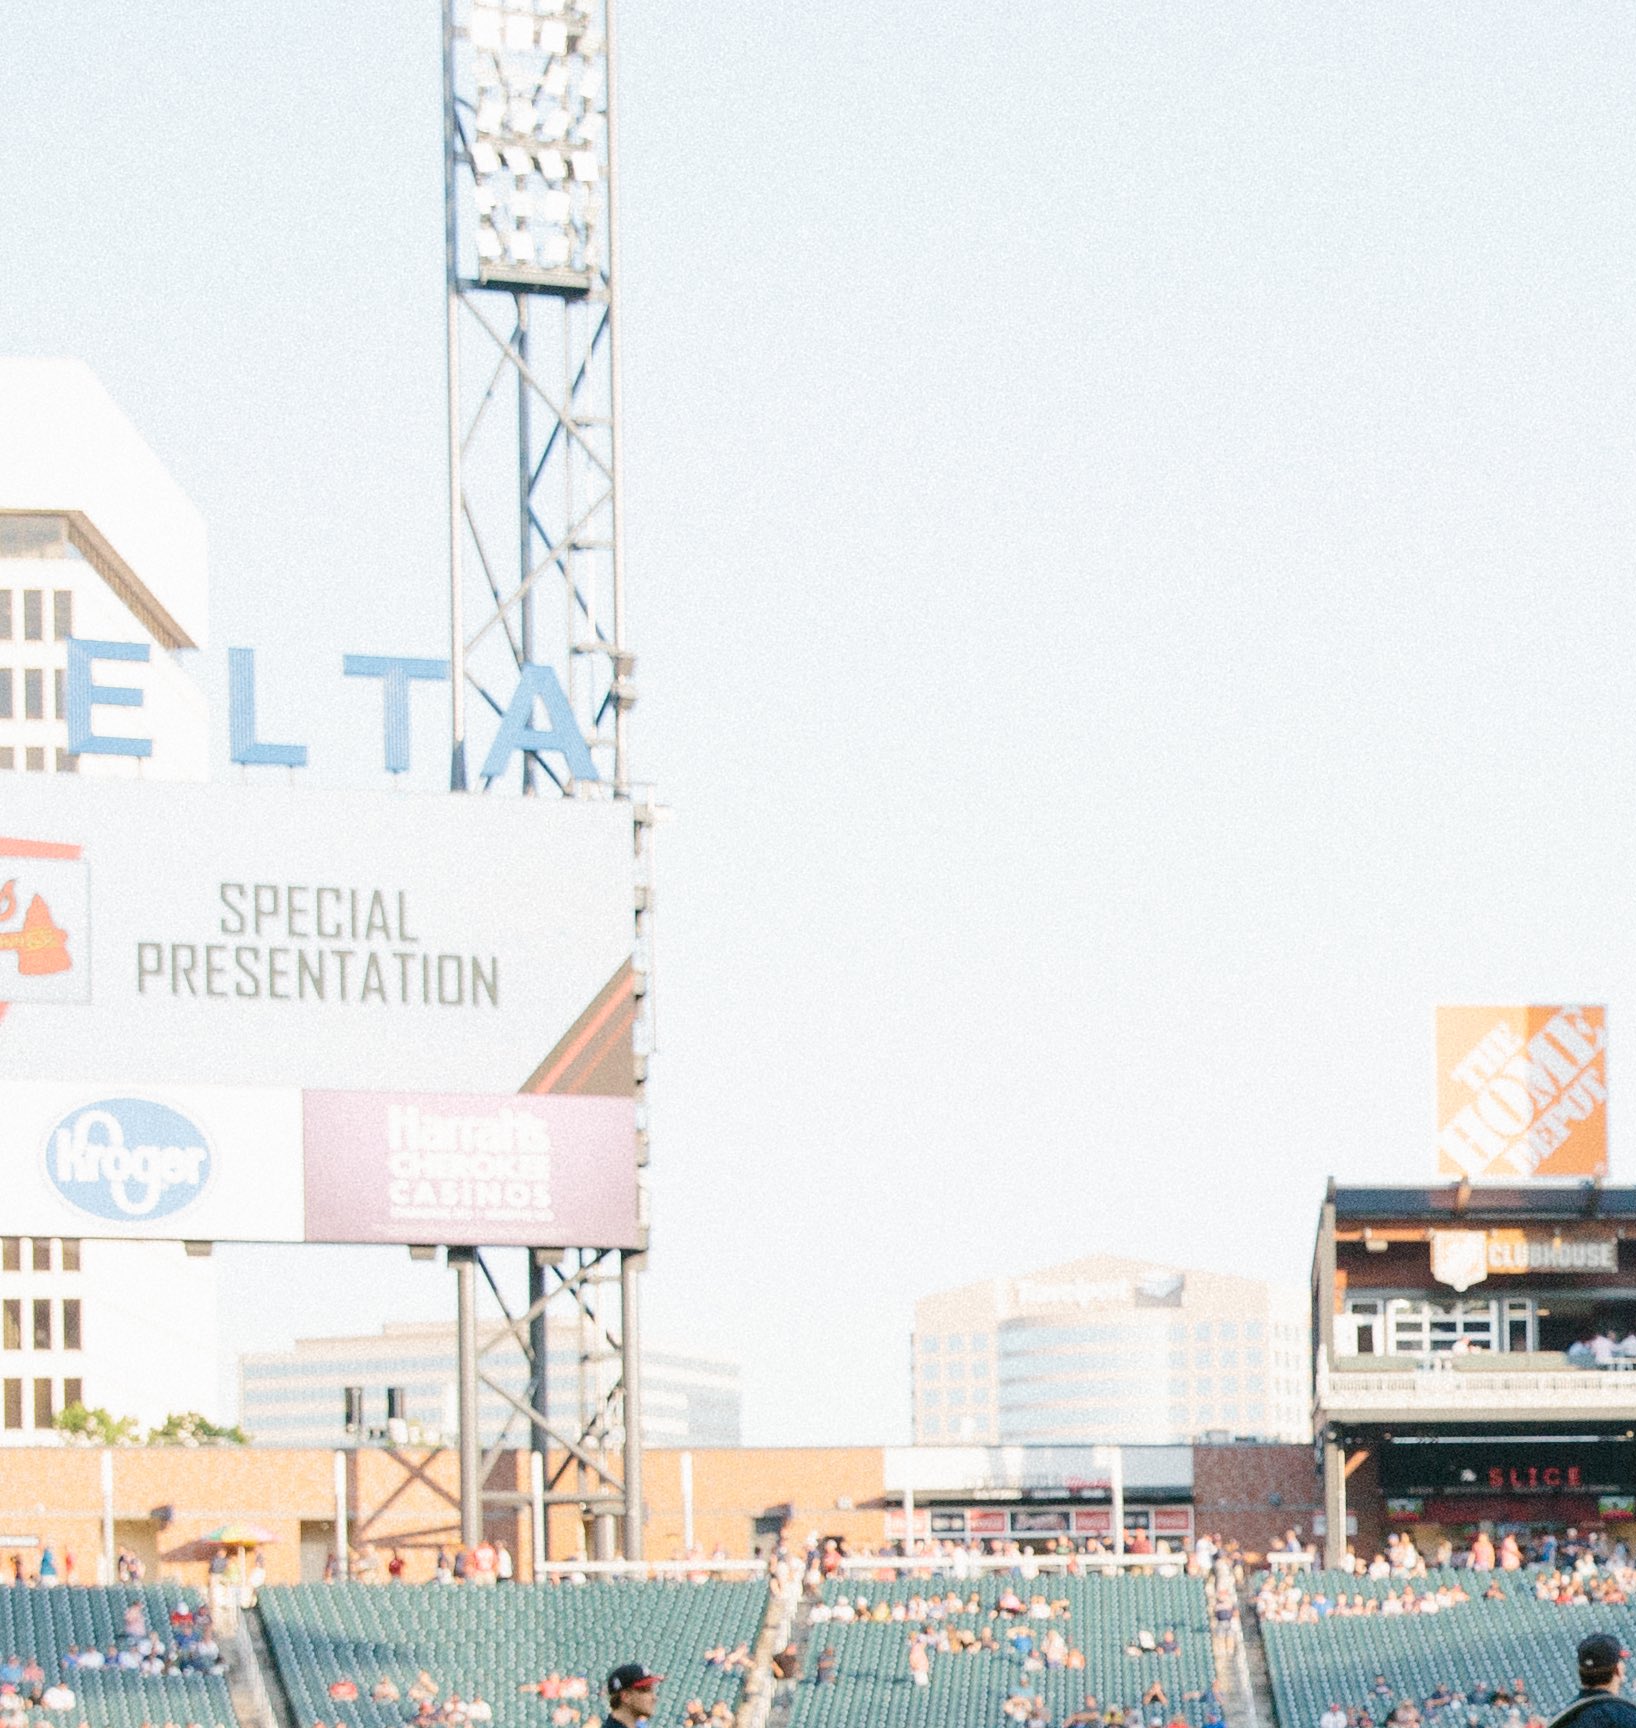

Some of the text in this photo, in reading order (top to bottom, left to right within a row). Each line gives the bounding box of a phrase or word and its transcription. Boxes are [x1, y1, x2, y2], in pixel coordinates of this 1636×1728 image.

[219, 882, 419, 942] SPECIAL
[136, 941, 500, 1008] PRESENTATION
[1438, 1005, 1606, 1174] HOME
[56, 1109, 208, 1215] Kroger
[388, 1179, 551, 1207] CASINOS
[1489, 1241, 1613, 1268] CLUBHOUSE
[1487, 1465, 1582, 1489] SLICE
